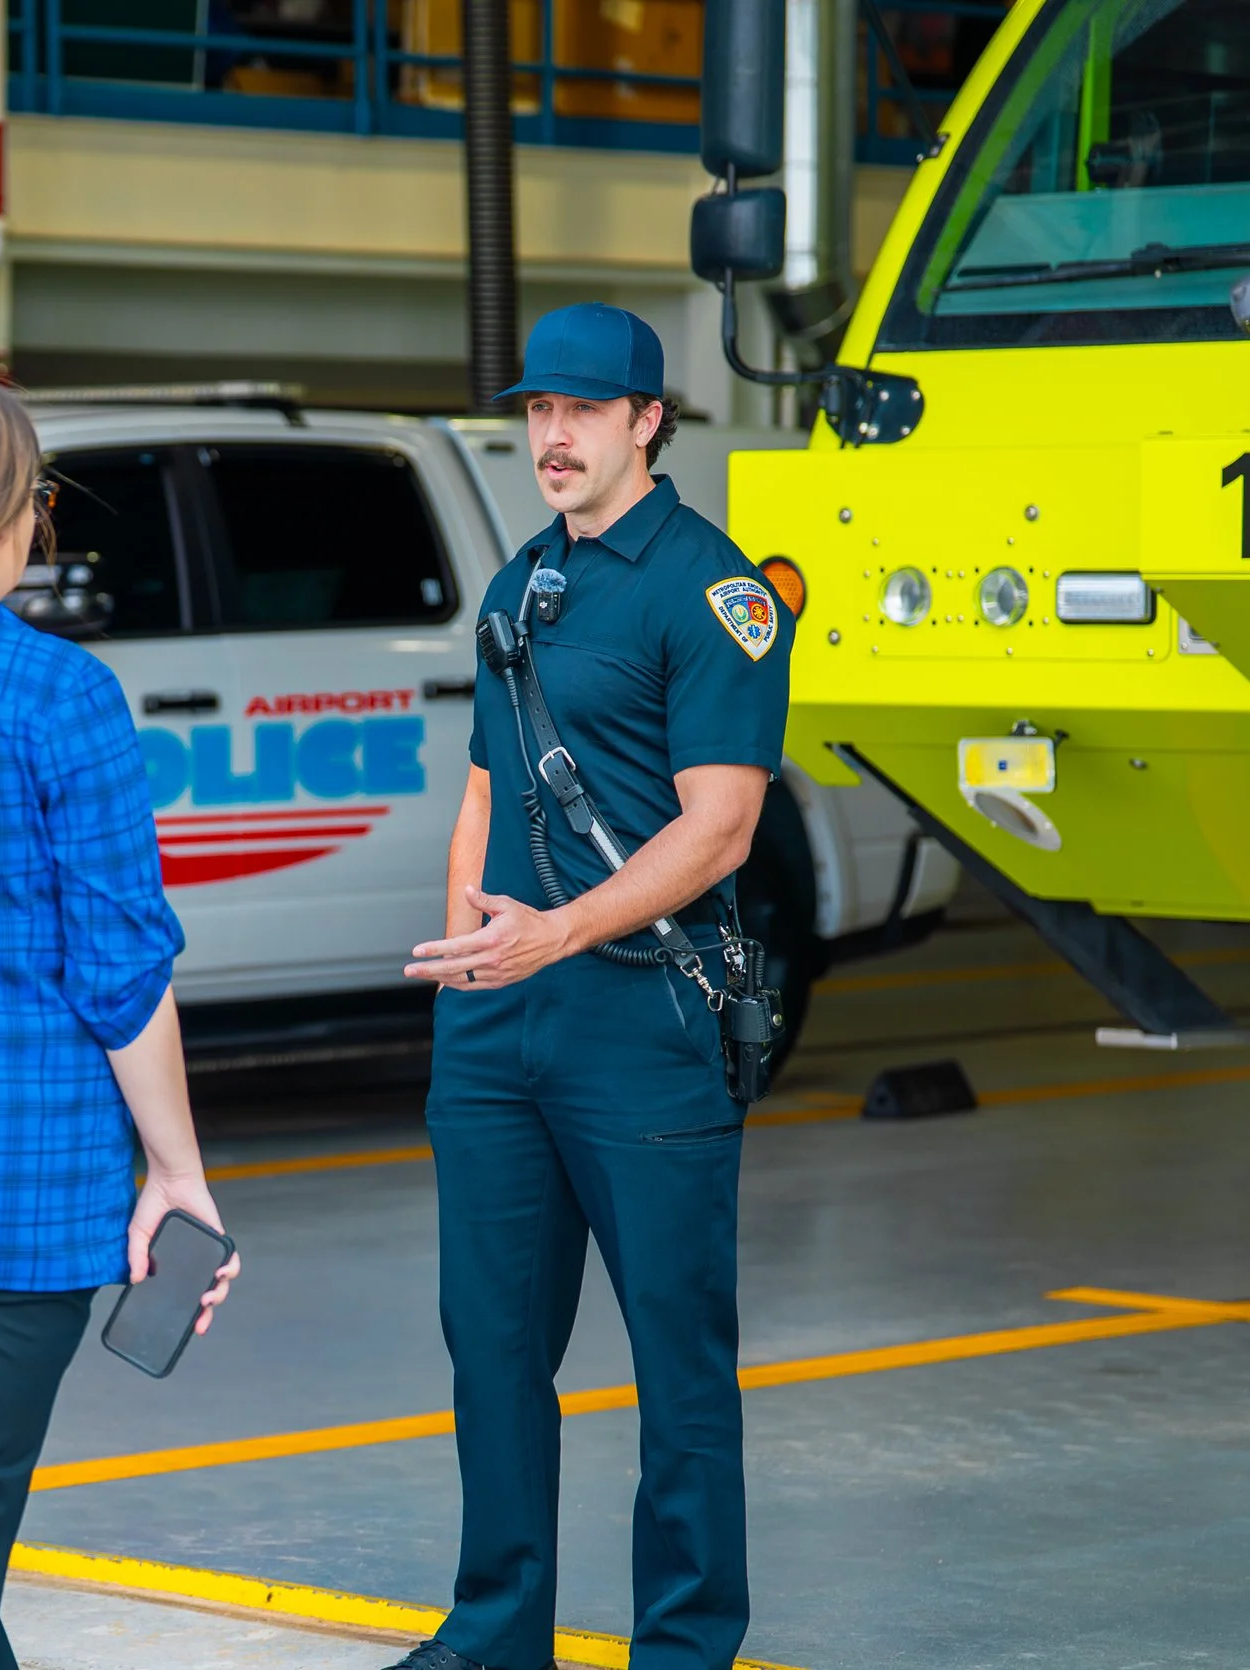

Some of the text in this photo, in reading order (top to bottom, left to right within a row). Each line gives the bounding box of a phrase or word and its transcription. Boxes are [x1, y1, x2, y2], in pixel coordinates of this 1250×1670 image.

[711, 582, 746, 597] METROPOLITAN
[720, 587, 740, 598] AIRPORT
[718, 605, 742, 637] DEPARTMENT
[244, 689, 416, 718] AIRPORT
[137, 715, 427, 812] OLICE
